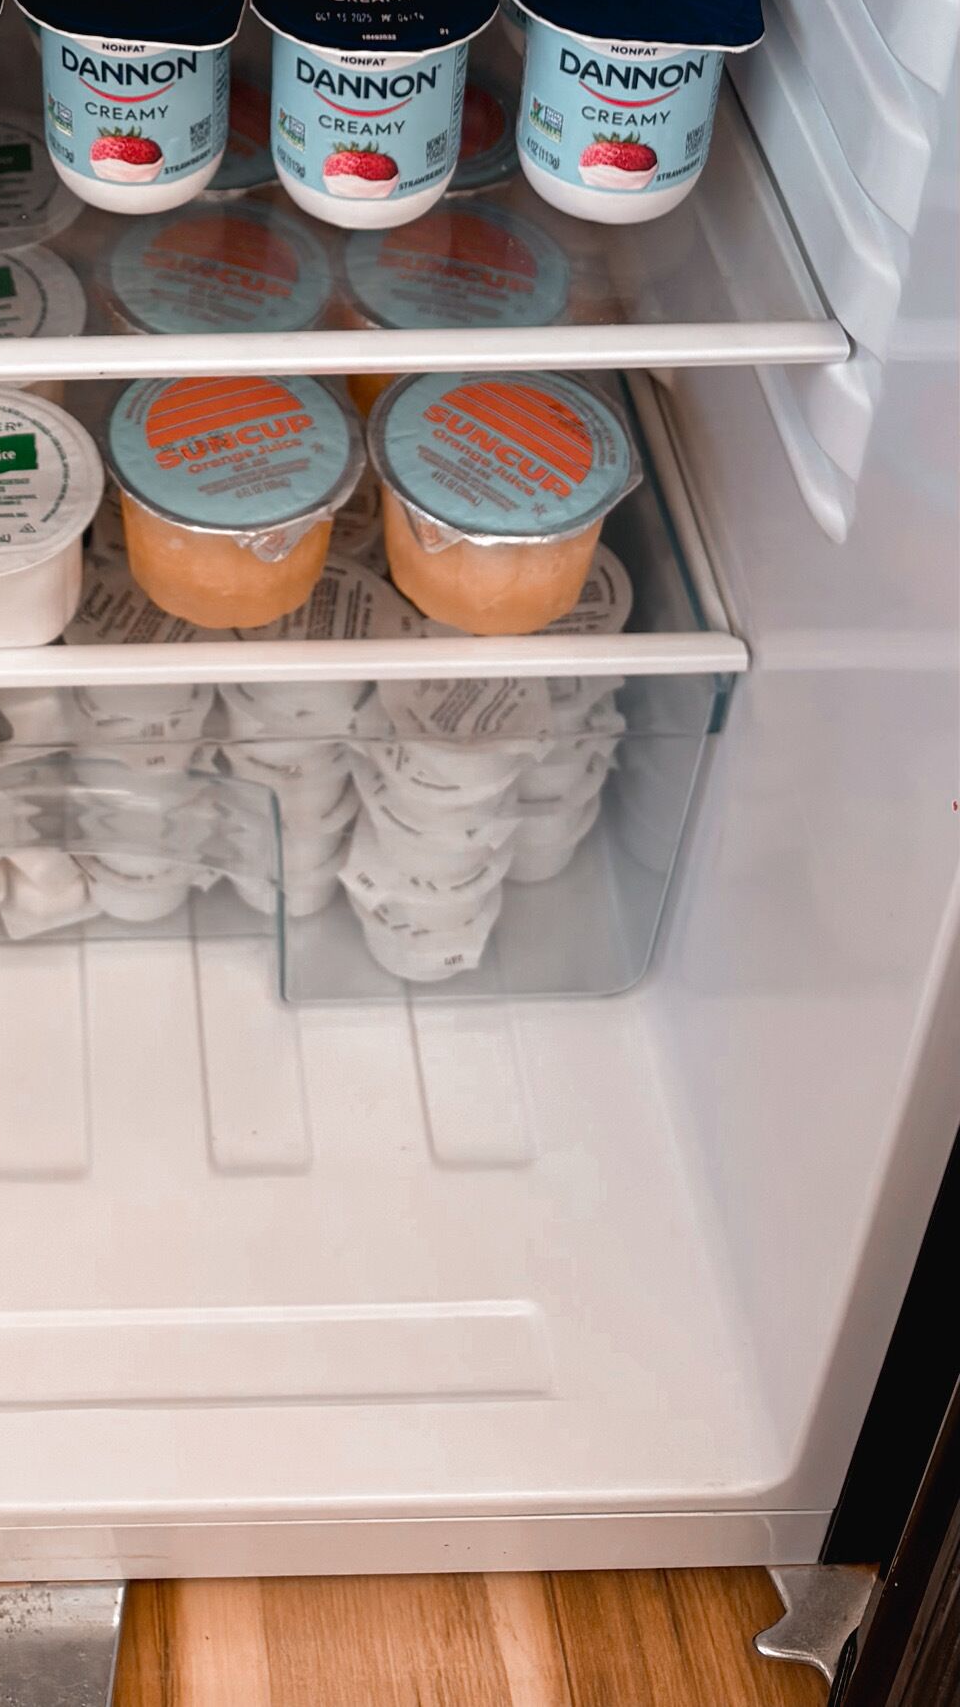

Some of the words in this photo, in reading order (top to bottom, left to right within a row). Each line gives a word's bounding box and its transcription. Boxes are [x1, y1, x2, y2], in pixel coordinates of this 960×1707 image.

[102, 43, 146, 53] NONFAT
[611, 45, 658, 56] NONFAT
[61, 45, 198, 86] DANNON
[341, 55, 386, 67] NONFAT
[560, 49, 705, 91] DANNON
[296, 57, 437, 99] DANNON
[85, 101, 169, 122] CREAMY
[581, 106, 671, 126] CREAMY
[318, 114, 406, 136] CREAMY
[154, 414, 314, 471] SUNCUP
[423, 404, 572, 500] SUNCUP
